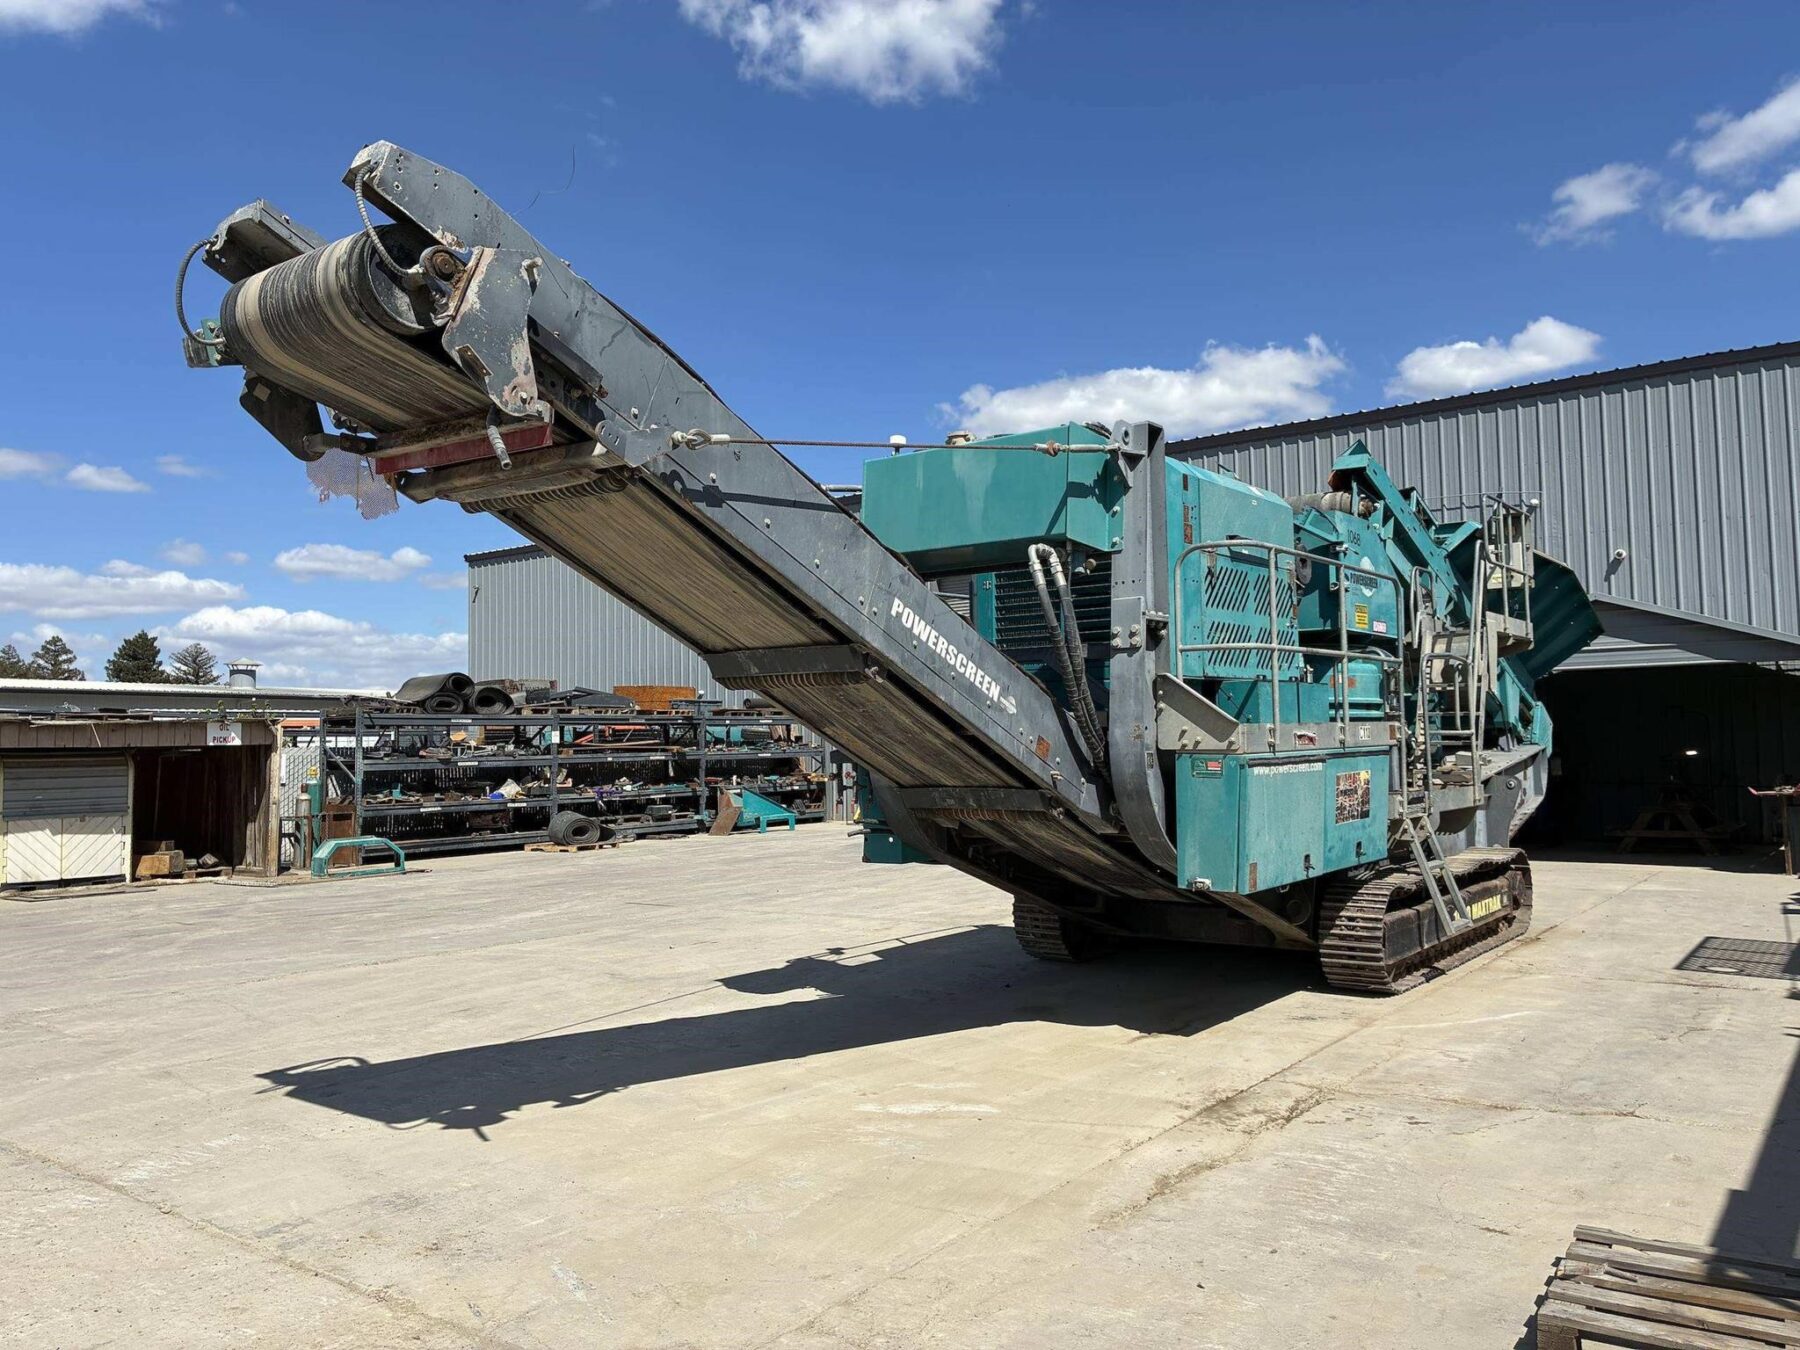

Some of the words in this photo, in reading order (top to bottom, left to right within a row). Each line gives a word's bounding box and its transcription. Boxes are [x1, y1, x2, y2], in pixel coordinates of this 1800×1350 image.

[890, 596, 1001, 703] POWERSCREEN
[219, 723, 231, 731] OIL
[212, 735, 236, 744] PICKUP
[1253, 762, 1323, 778] www.powerscreen.com
[1471, 893, 1502, 920] MAXTRAK
